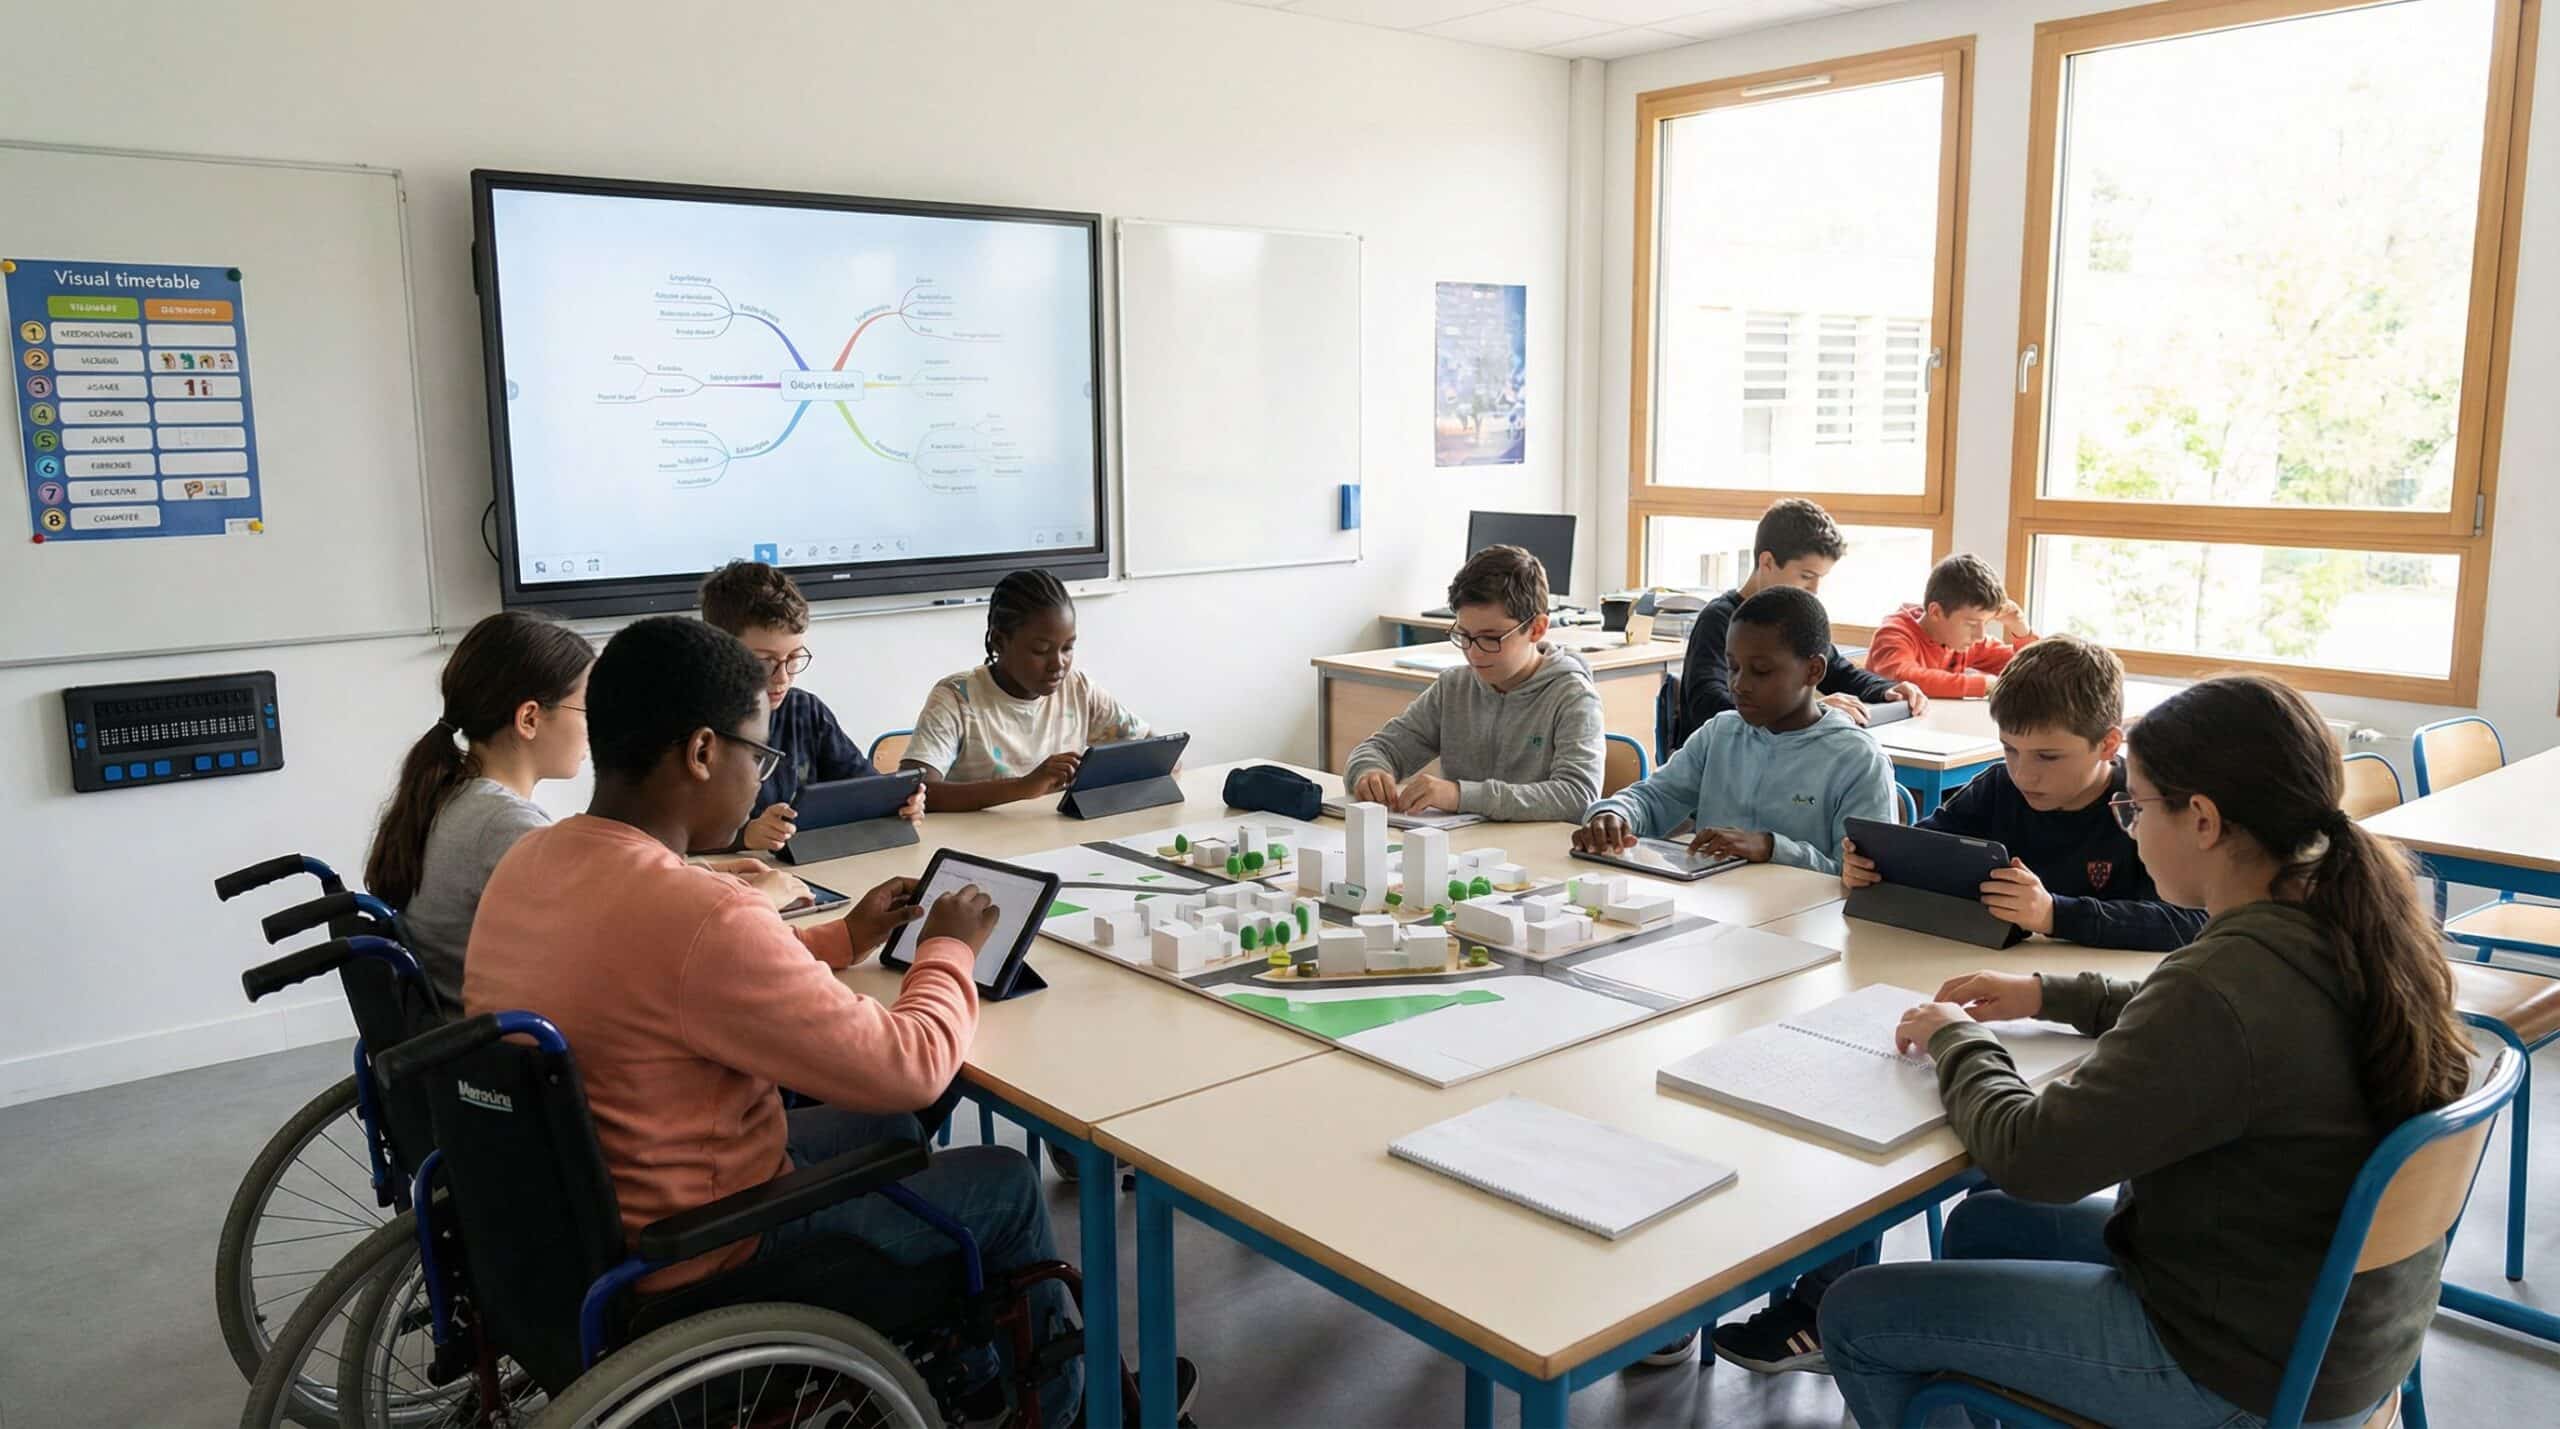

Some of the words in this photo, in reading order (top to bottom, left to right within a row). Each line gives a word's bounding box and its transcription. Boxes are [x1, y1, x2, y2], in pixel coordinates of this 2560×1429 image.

[53, 269, 110, 287] Visual
[115, 271, 201, 290] timetable
[29, 327, 38, 341] 1
[31, 354, 42, 367] 2
[34, 380, 45, 394] 3
[37, 409, 48, 421] 4
[41, 435, 52, 448] 5
[43, 461, 55, 474] 6
[46, 488, 57, 501] 7
[49, 514, 61, 527] 8
